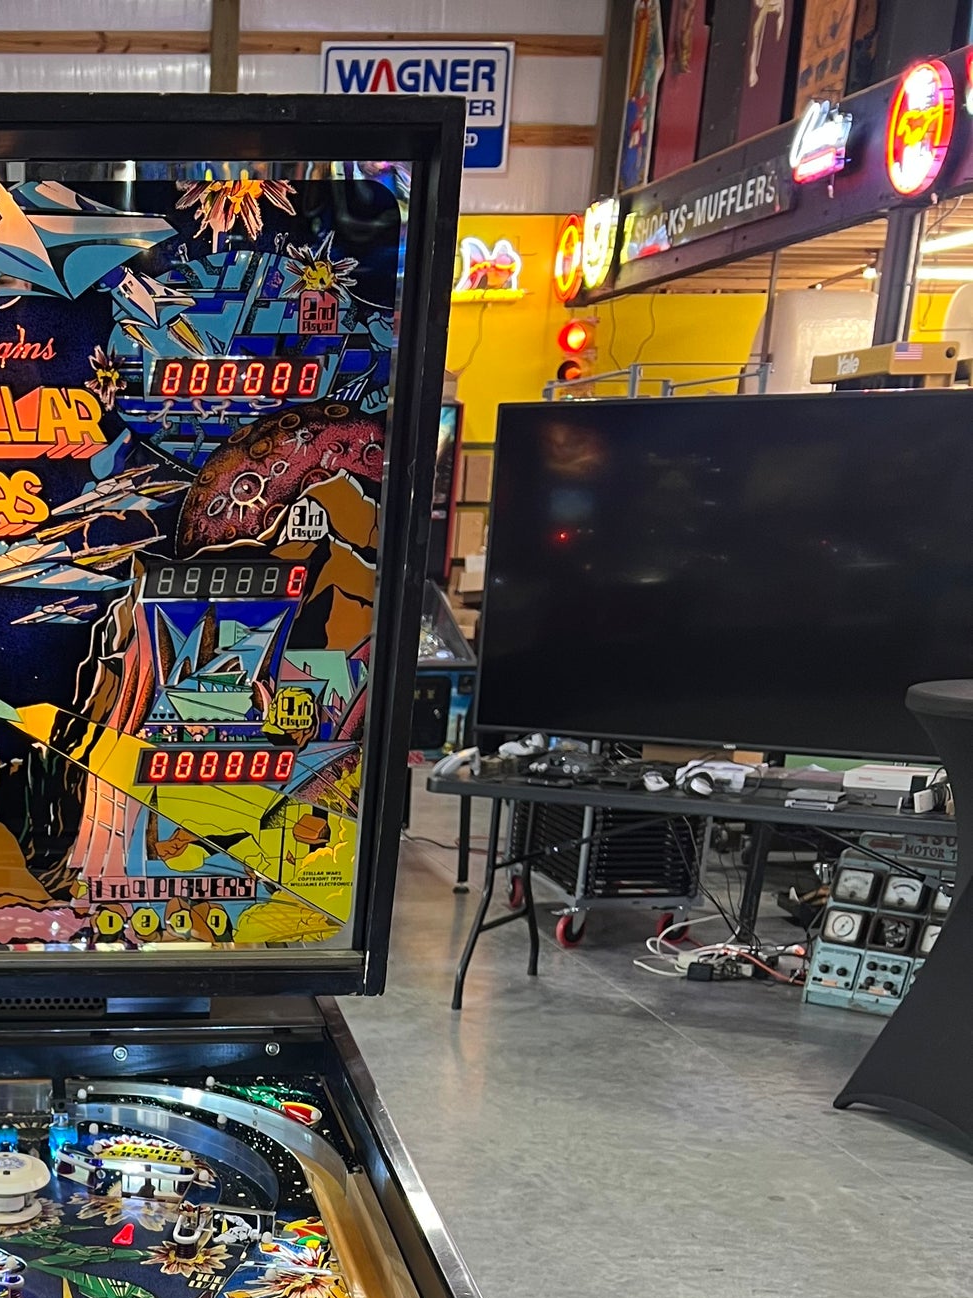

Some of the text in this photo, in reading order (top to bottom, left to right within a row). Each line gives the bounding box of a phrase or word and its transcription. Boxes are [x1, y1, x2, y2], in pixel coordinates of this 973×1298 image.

[336, 58, 496, 93] WAGNER
[837, 353, 860, 375] Yale
[904, 844, 946, 859] MOTOR
[153, 877, 253, 898] PLAYERS
